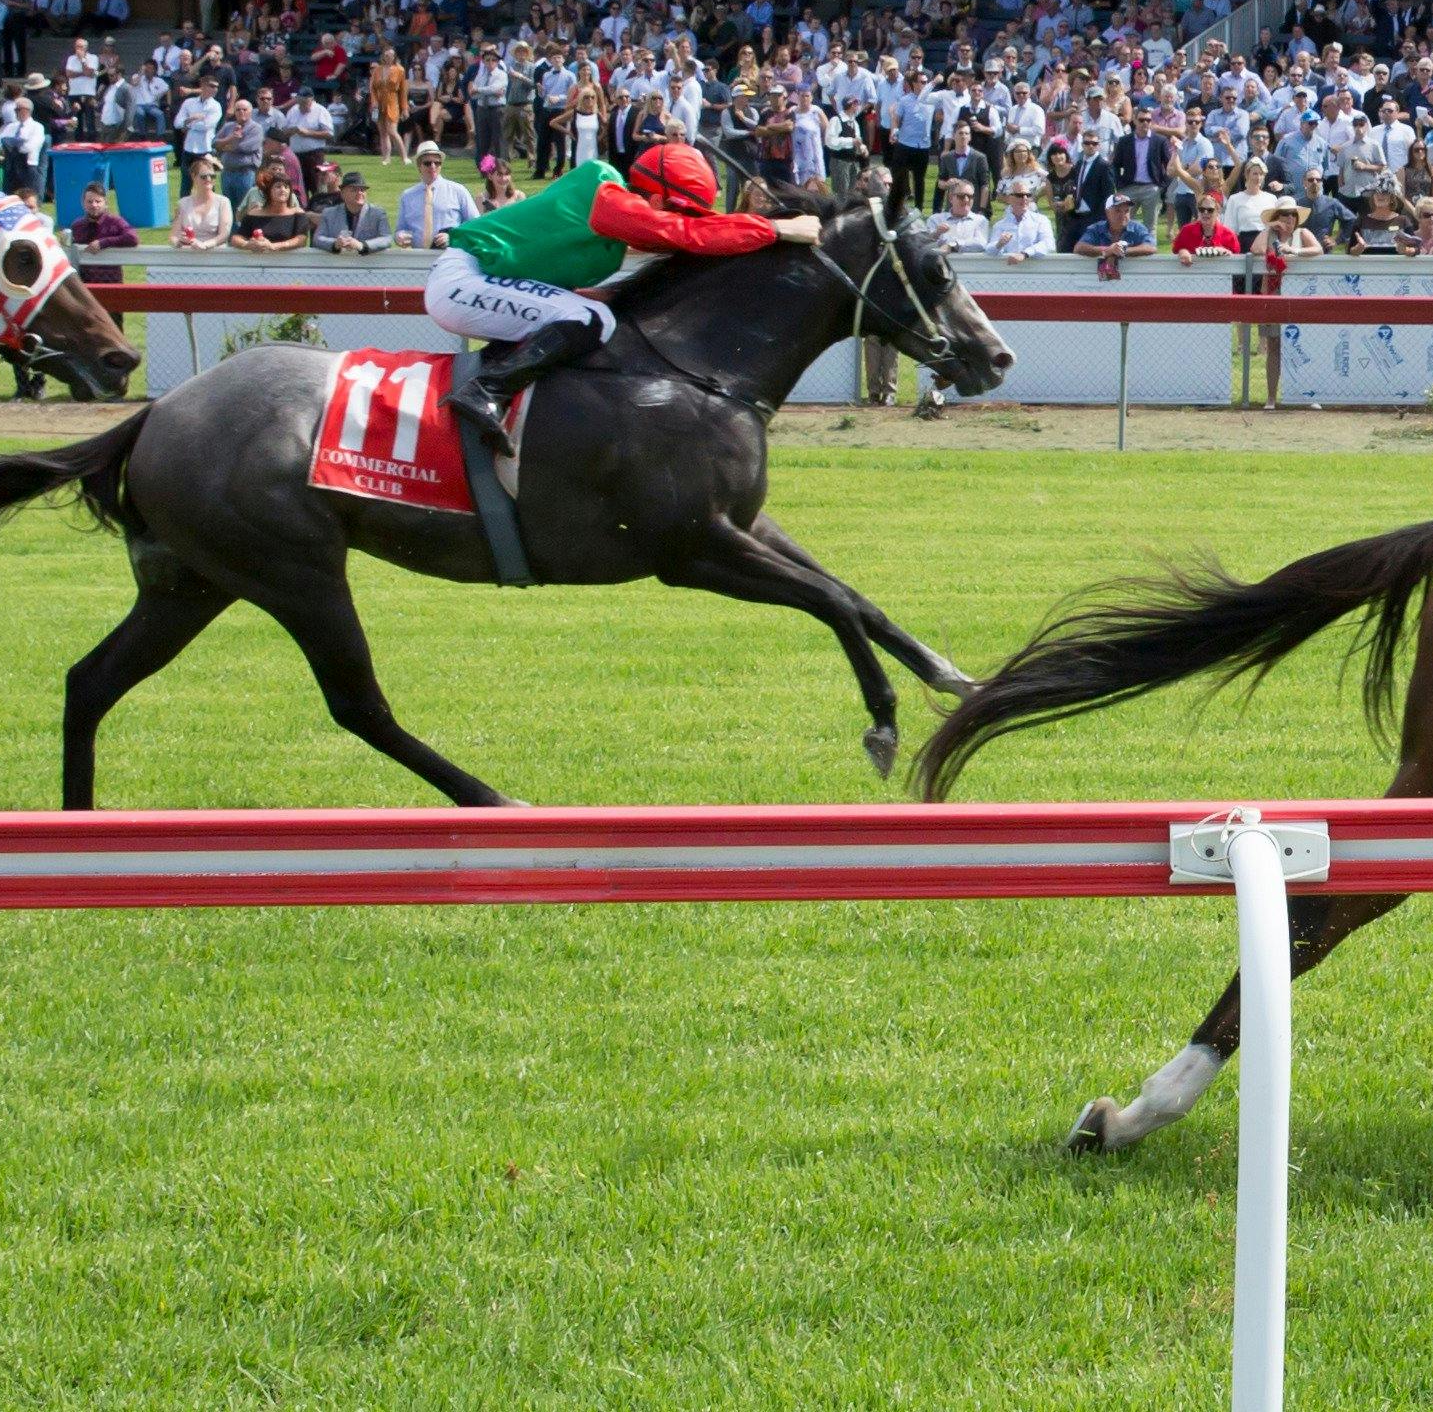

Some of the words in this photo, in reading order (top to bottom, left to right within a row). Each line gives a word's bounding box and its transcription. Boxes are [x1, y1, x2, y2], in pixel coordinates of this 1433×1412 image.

[337, 360, 434, 464] 11
[321, 447, 442, 484] COMMERCIAL
[353, 474, 403, 496] CLUB
